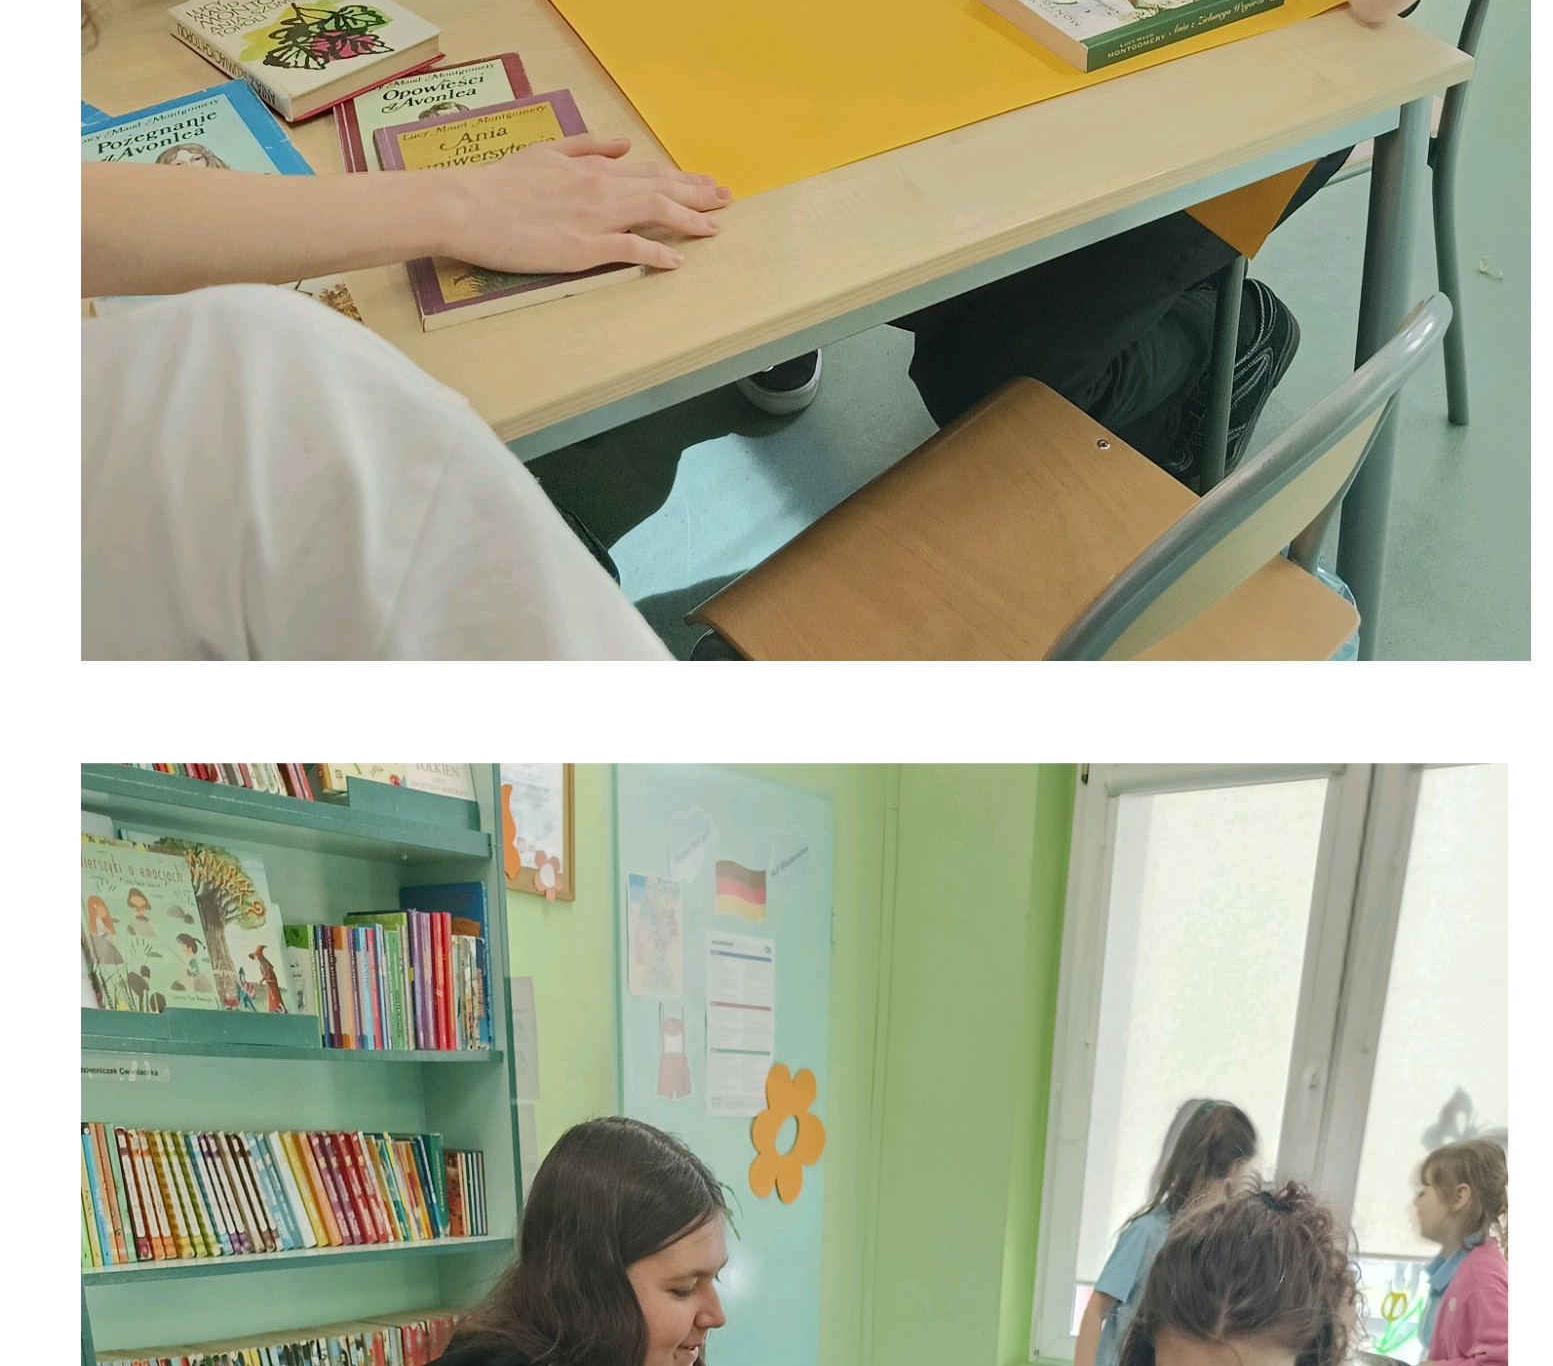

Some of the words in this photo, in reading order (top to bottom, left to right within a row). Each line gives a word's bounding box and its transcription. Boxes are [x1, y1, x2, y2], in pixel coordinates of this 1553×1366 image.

[186, 0, 223, 17] LUCY
[193, 1, 240, 22] MAUD
[210, 16, 247, 35] ANIA
[216, 15, 268, 38] TOPOLI
[1107, 34, 1167, 59] MONTGOMERY
[382, 72, 484, 101] Opowieści
[396, 88, 478, 110] Avonlea
[97, 111, 218, 155] Pożegnanie
[402, 130, 431, 142] Lucy
[430, 121, 468, 136] Maud
[471, 104, 547, 128] Montgomery
[115, 123, 206, 163] Avonlea
[439, 126, 509, 152] Ania
[455, 142, 480, 156] na
[128, 865, 134, 875] o
[140, 863, 184, 885] emocjach
